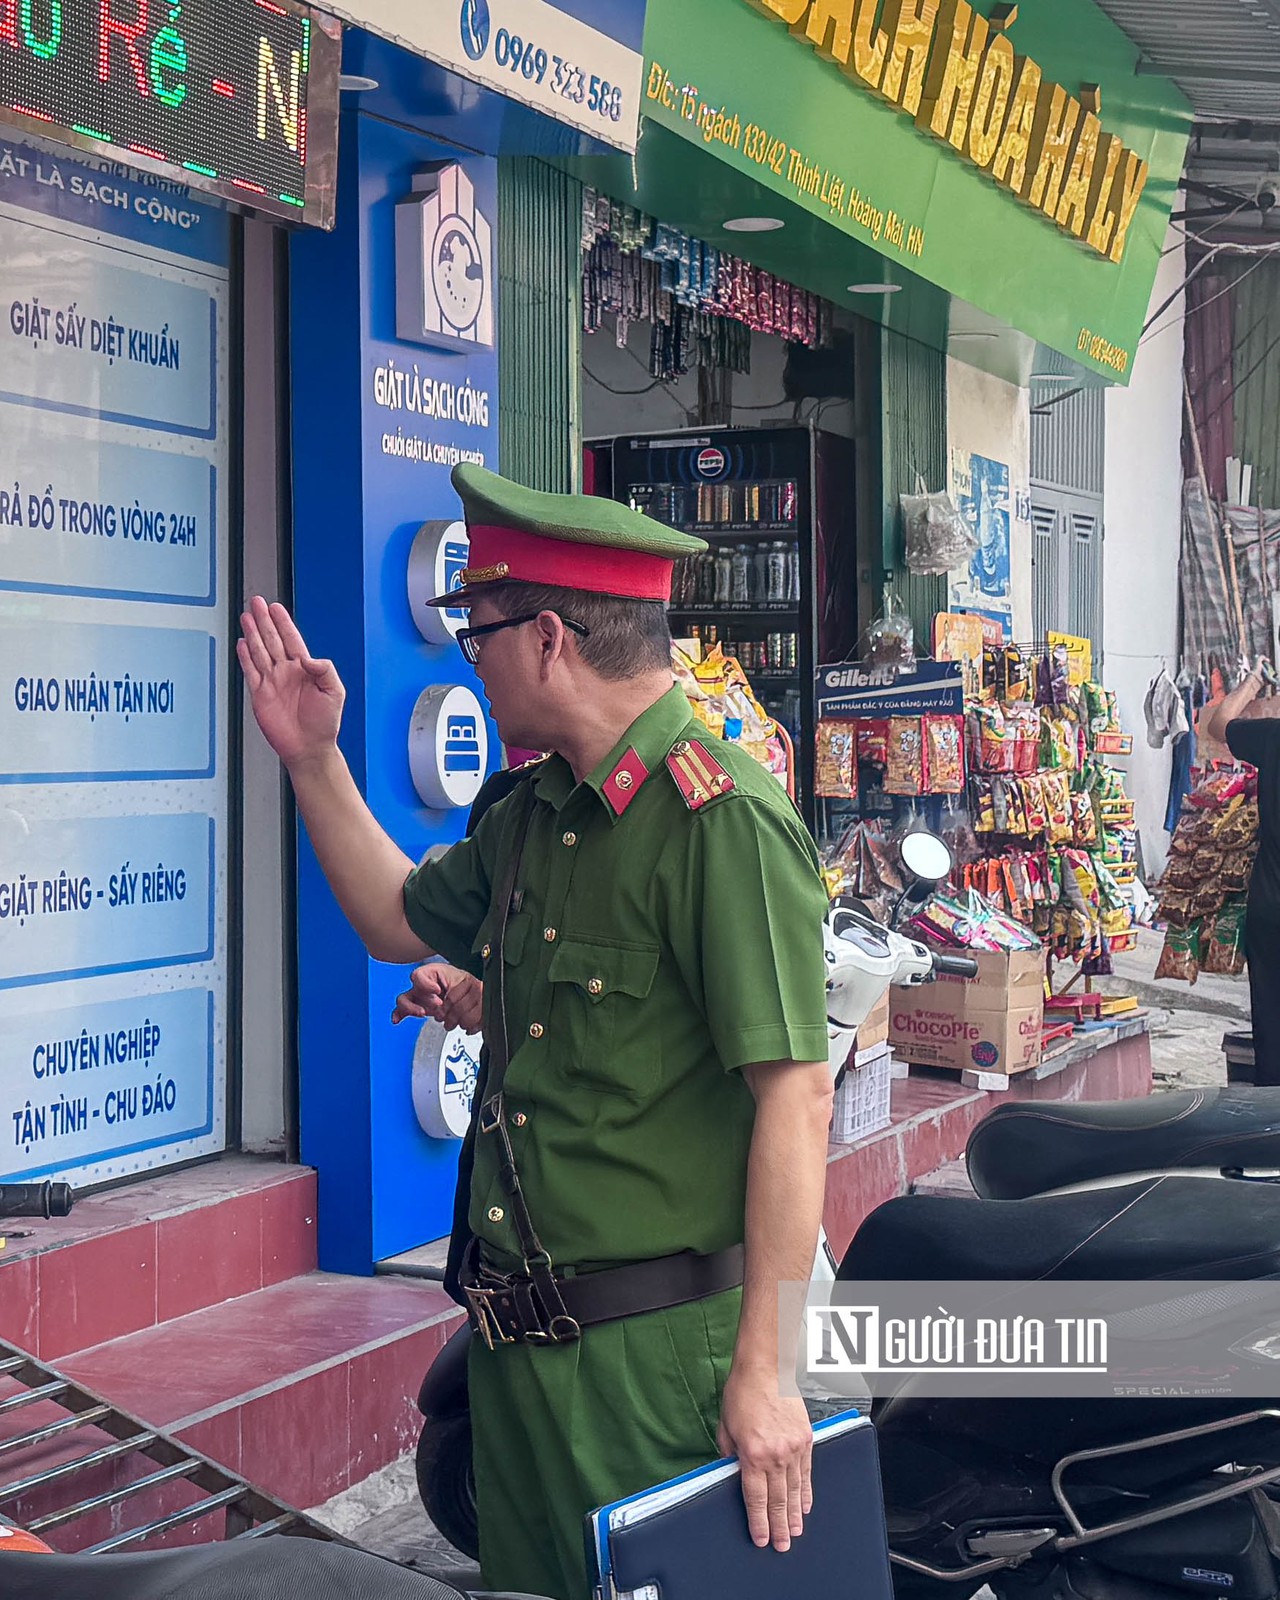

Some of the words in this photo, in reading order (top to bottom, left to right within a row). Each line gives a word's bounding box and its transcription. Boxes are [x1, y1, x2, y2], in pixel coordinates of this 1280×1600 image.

[495, 28, 547, 86] 0969
[550, 55, 586, 105] 323
[588, 75, 622, 122] 588
[36, 165, 65, 190] LÀ
[70, 176, 128, 211] SẠCH
[696, 105, 741, 144] ngách
[743, 122, 787, 176] 133/42
[787, 148, 821, 197] Thịnh
[906, 223, 927, 257] HN
[10, 297, 51, 350] GIẶT
[55, 302, 84, 349] SẤY
[91, 315, 125, 368] DIỆT
[128, 323, 180, 371] KHUẨN
[374, 359, 403, 411] GIẶT
[405, 364, 422, 414] LÀ
[423, 378, 455, 420] SẠCH
[457, 377, 489, 428] CỘNG
[28, 484, 55, 531] ĐỒ
[60, 499, 116, 538] TRONG
[121, 502, 166, 544] VÒNG
[170, 514, 196, 547] 24H
[14, 677, 60, 713] GIAO
[64, 672, 109, 722] NHẬN
[114, 673, 143, 722] TẬN
[147, 678, 174, 713] NƠI
[42, 870, 91, 913] RIÊNG
[109, 864, 137, 906] SẤY
[141, 864, 187, 904] RIÊNG
[32, 1028, 100, 1079] CHUYÊN
[104, 1018, 161, 1070] NGHIỆP
[12, 1103, 45, 1146] TẬN
[49, 1093, 88, 1137] TÌNH
[105, 1092, 138, 1123] CHU
[141, 1075, 177, 1116] ĐÁO
